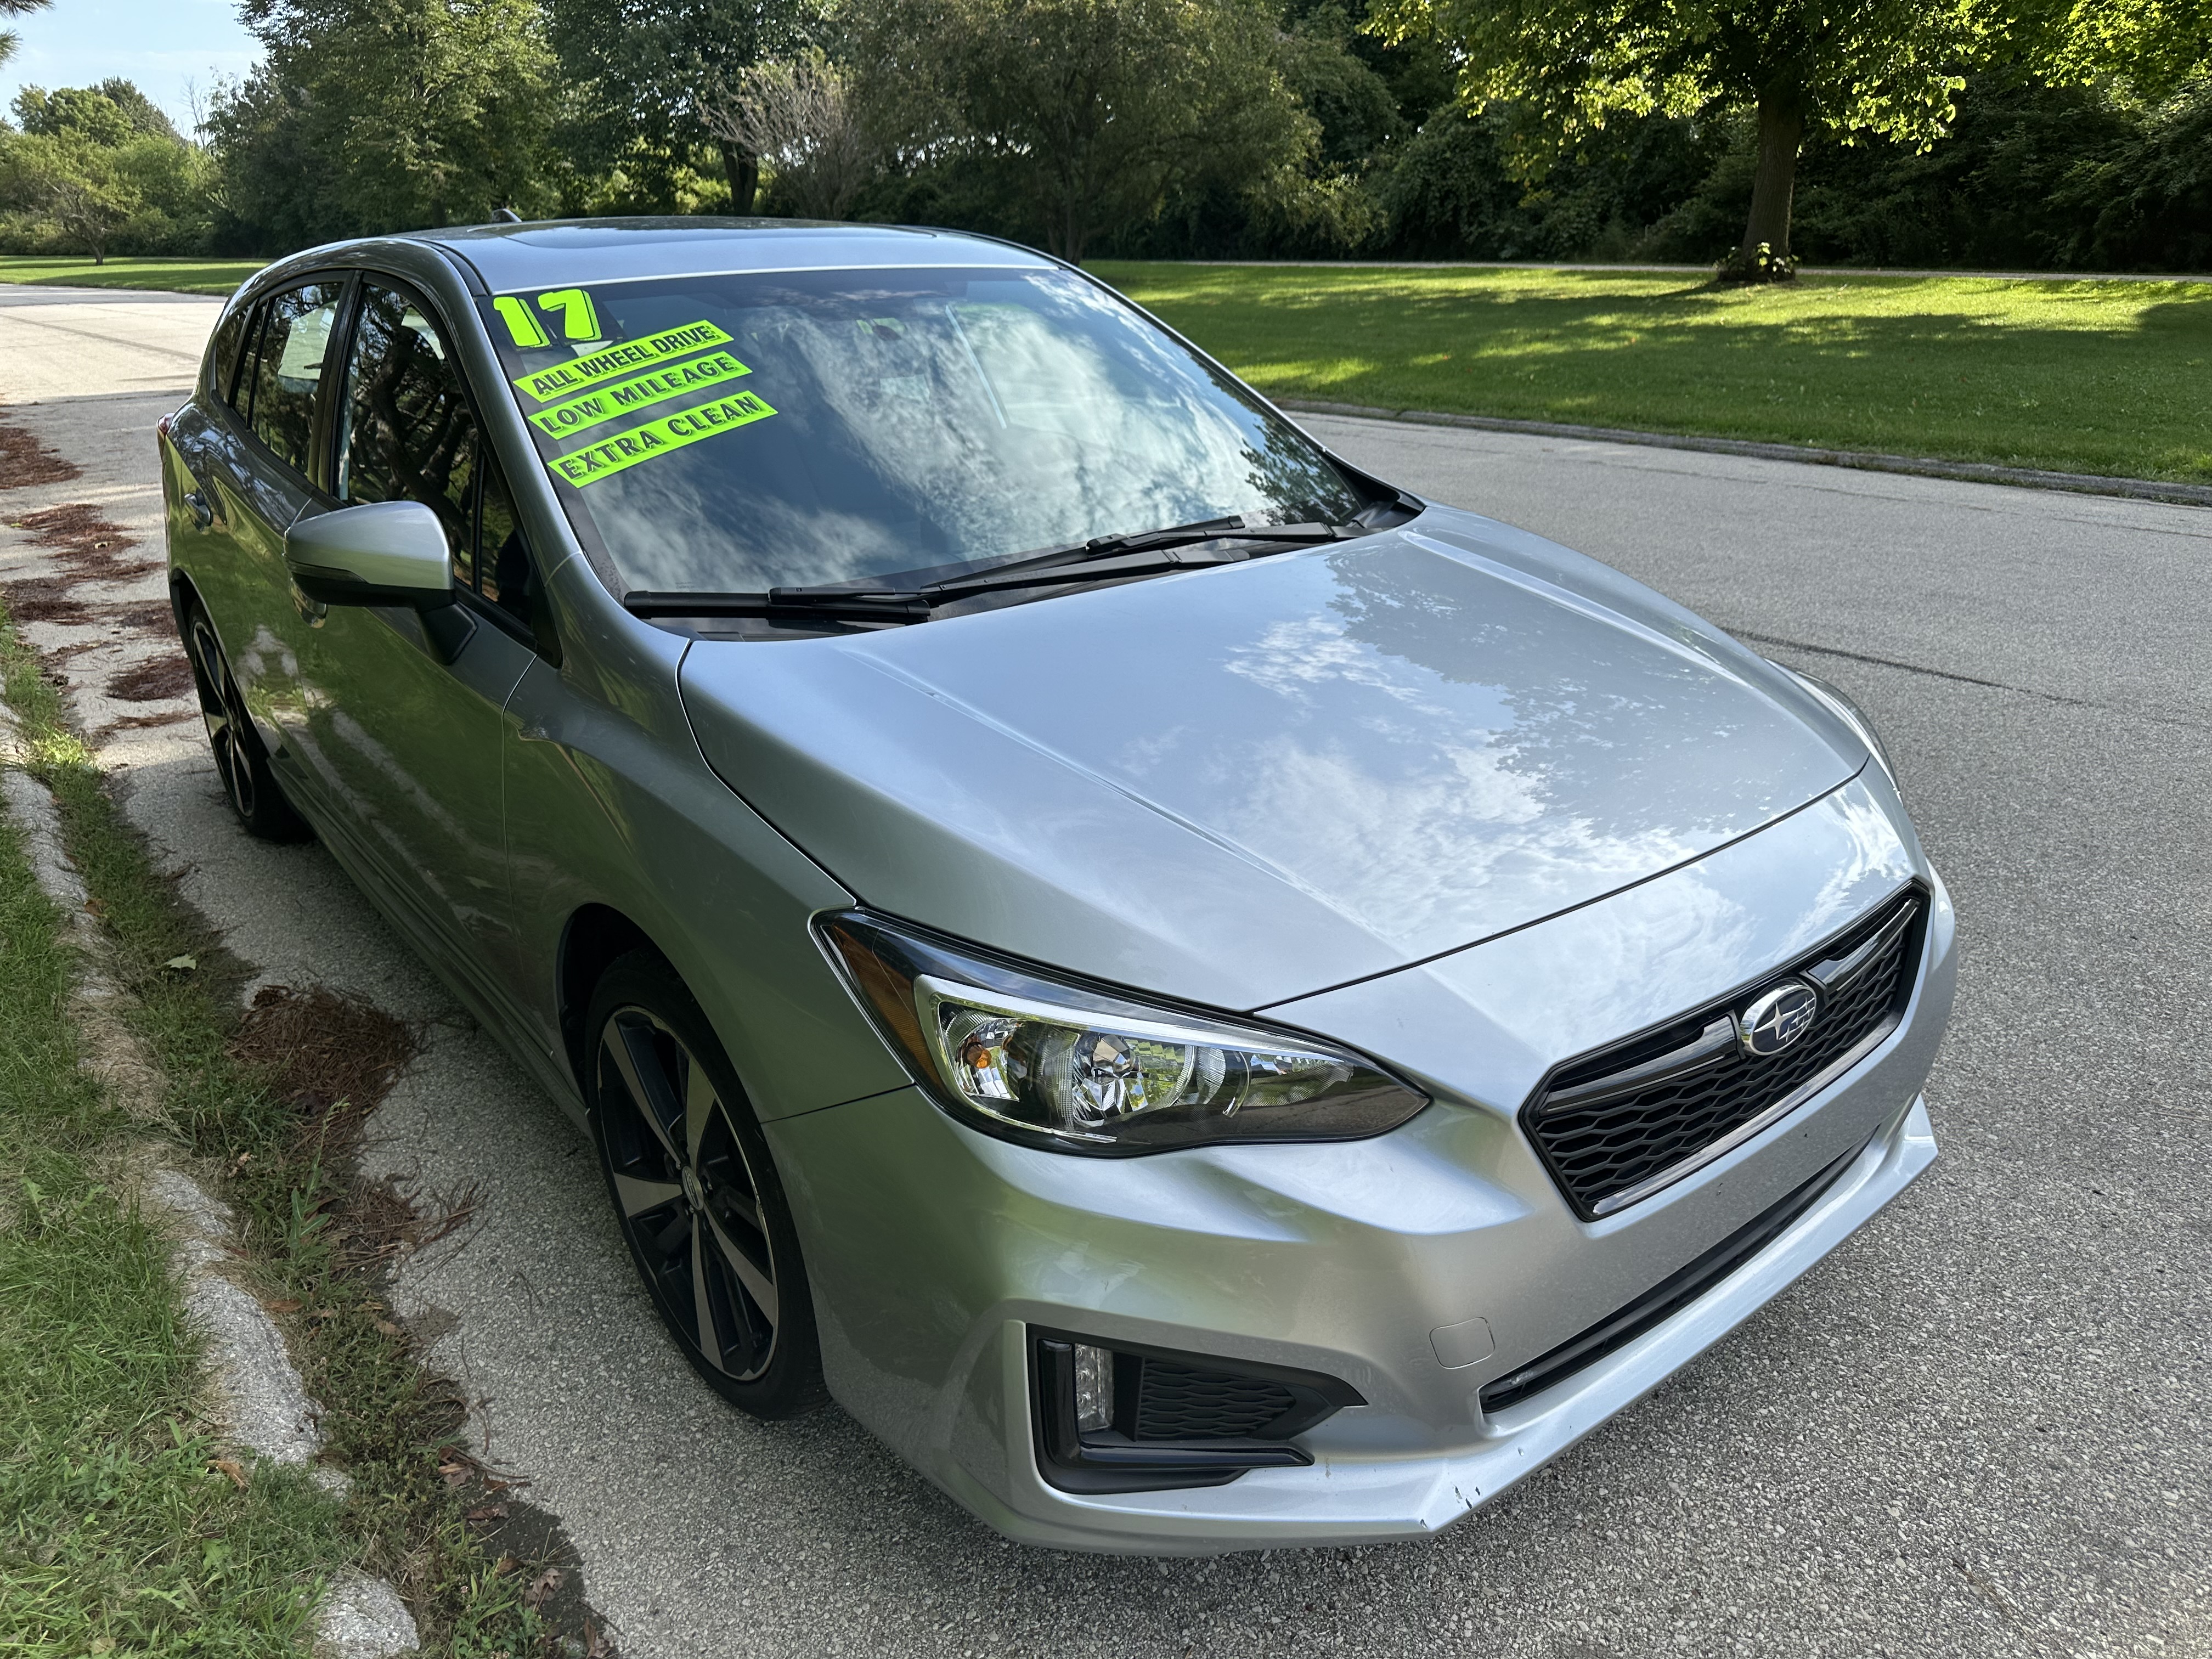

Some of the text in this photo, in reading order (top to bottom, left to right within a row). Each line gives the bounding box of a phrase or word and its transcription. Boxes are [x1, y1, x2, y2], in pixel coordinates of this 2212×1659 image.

[493, 289, 602, 347] 17
[532, 325, 721, 395] ALL WHEEL DRIVE
[539, 357, 737, 433] LOW MILEAGE
[558, 396, 761, 479] EXTRA CLEAN
